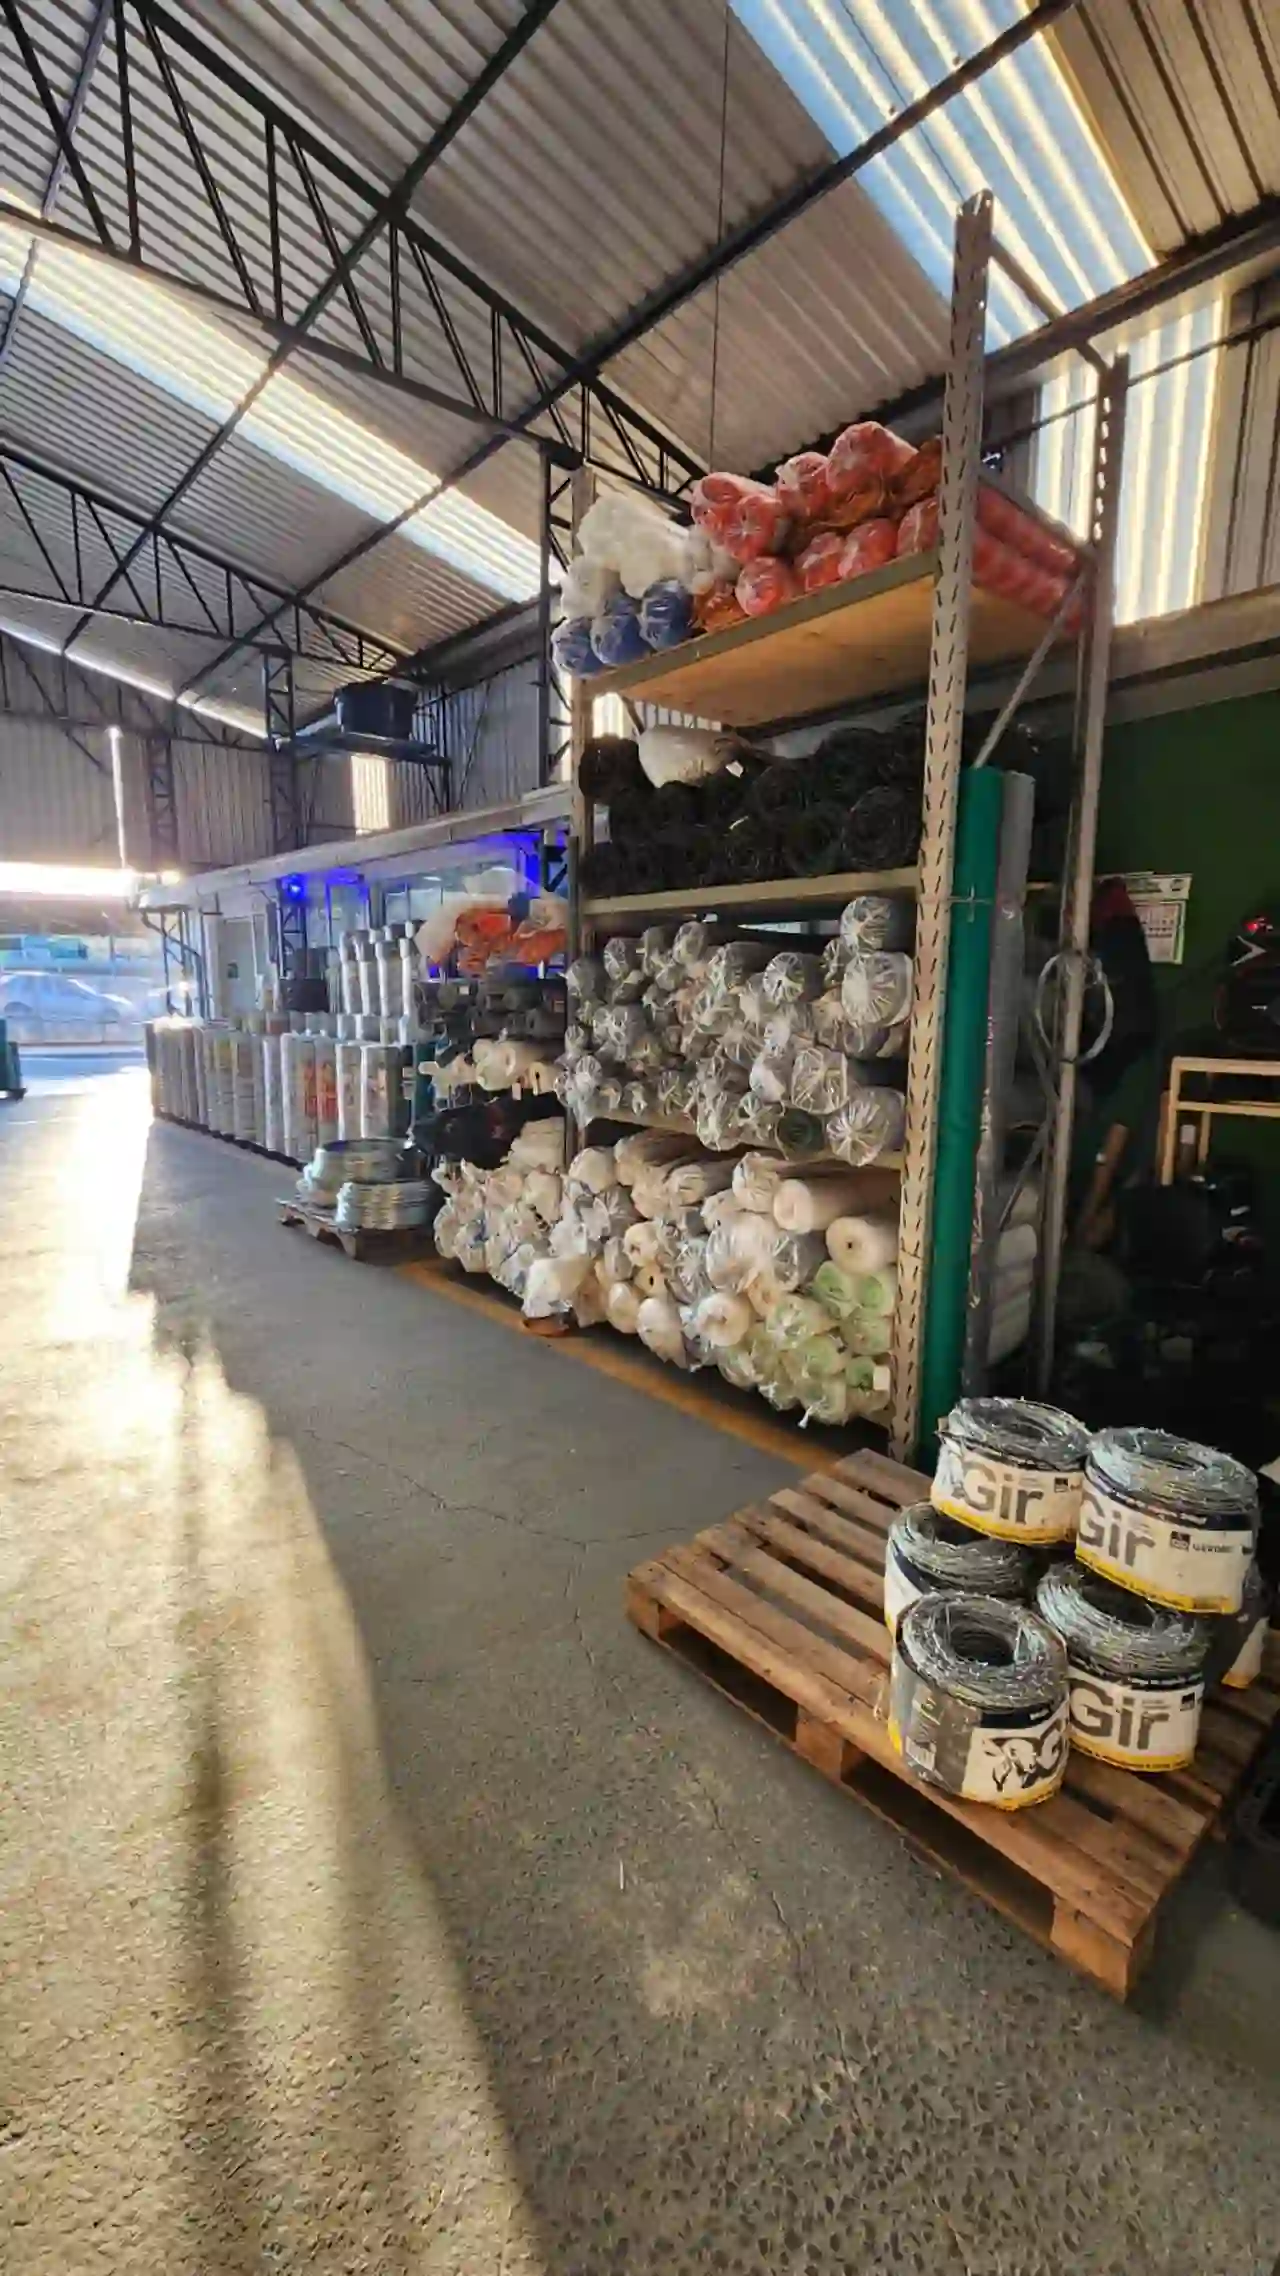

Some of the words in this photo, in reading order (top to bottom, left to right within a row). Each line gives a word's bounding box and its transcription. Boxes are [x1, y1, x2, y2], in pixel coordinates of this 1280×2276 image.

[961, 1461, 1044, 1525] Gir
[1079, 1491, 1156, 1568] Gir
[1068, 1678, 1170, 1750] Gir
